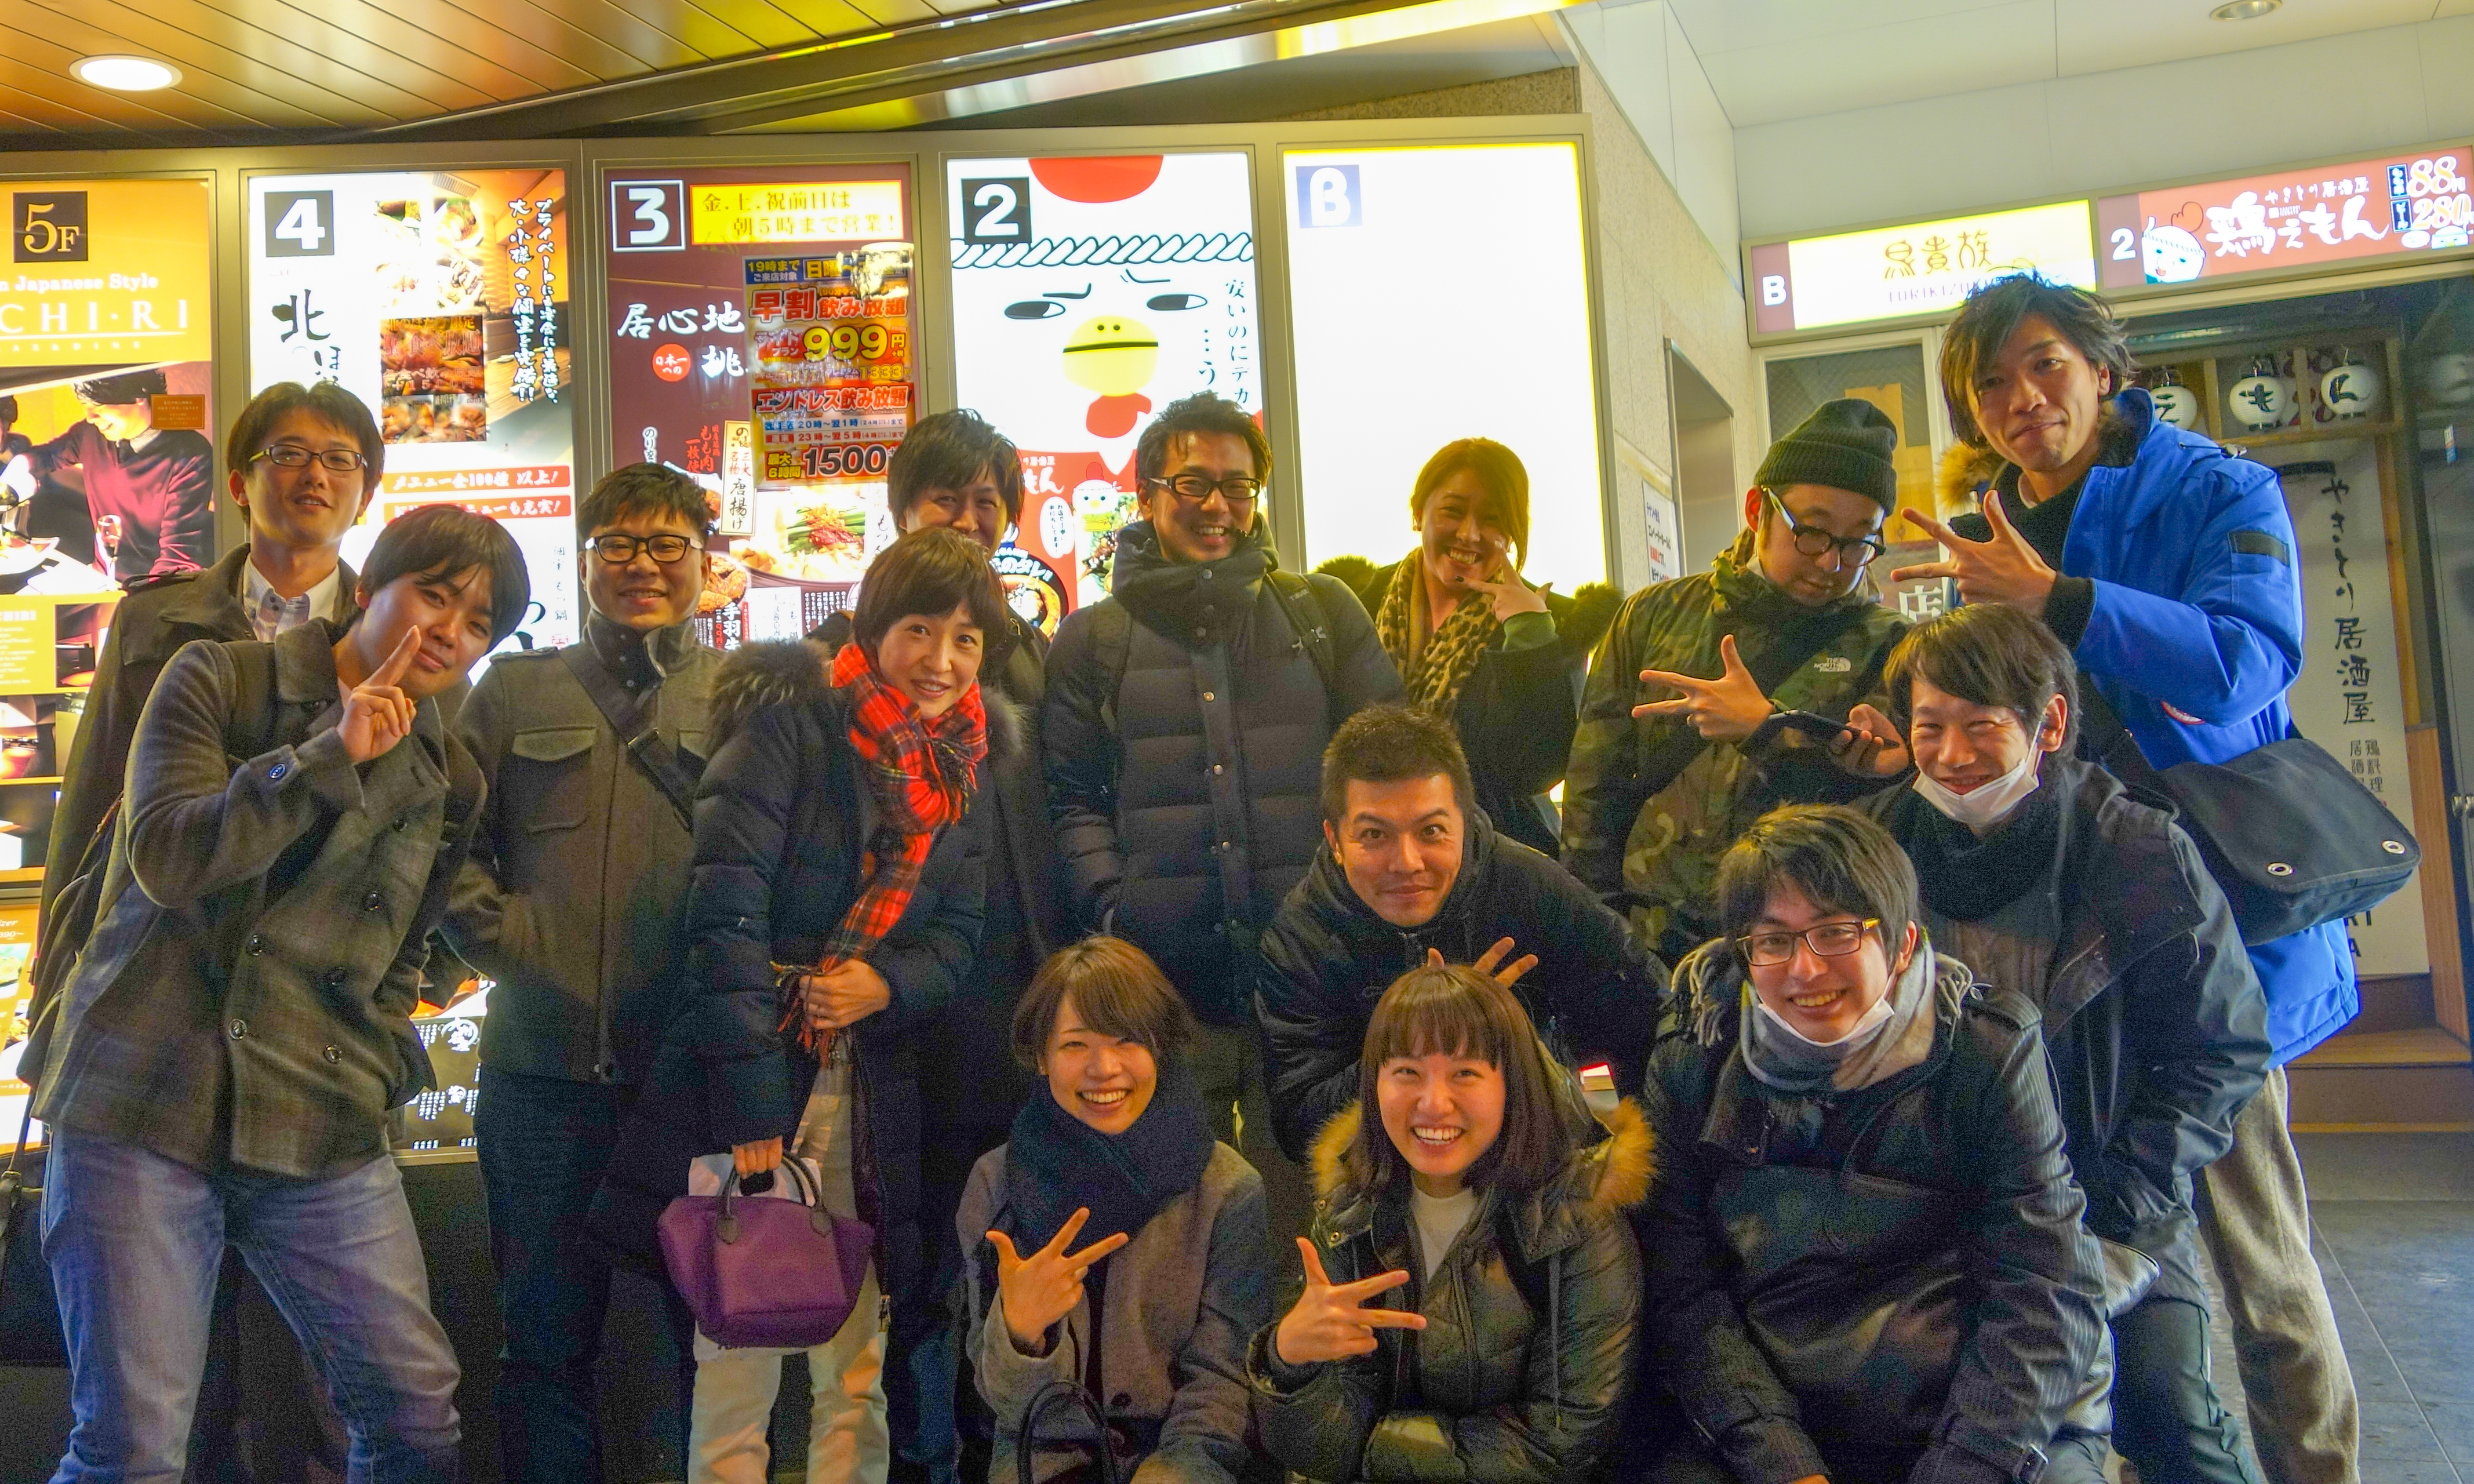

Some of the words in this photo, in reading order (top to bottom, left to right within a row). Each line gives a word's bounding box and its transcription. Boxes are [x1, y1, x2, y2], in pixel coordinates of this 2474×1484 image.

[973, 183, 1019, 237] 2
[1309, 167, 1351, 227] B
[24, 202, 79, 253] 5F
[275, 198, 325, 249] 4
[628, 187, 670, 244] 3
[2111, 228, 2136, 261] 2
[748, 260, 799, 272] 19時まで
[754, 272, 797, 282] ご来店対象
[15, 275, 103, 294] Japanese
[110, 272, 159, 292] Style
[1763, 275, 1787, 306] B
[617, 301, 745, 340] 居心地
[750, 289, 817, 323] 早割
[817, 296, 907, 319] 飲み放題
[656, 354, 687, 366] 日本一
[803, 325, 888, 363] 999
[891, 333, 905, 348] 円
[662, 366, 682, 374] への
[758, 385, 909, 413] エンドレス飲み放題
[2239, 383, 2276, 412] も
[767, 453, 792, 465] 最大
[768, 465, 801, 478] 6時間
[803, 445, 887, 476] 1500
[730, 478, 747, 530] 唐揚げ
[2321, 475, 2375, 724] やきとり居酒屋
[2365, 739, 2385, 792] 鶏料理
